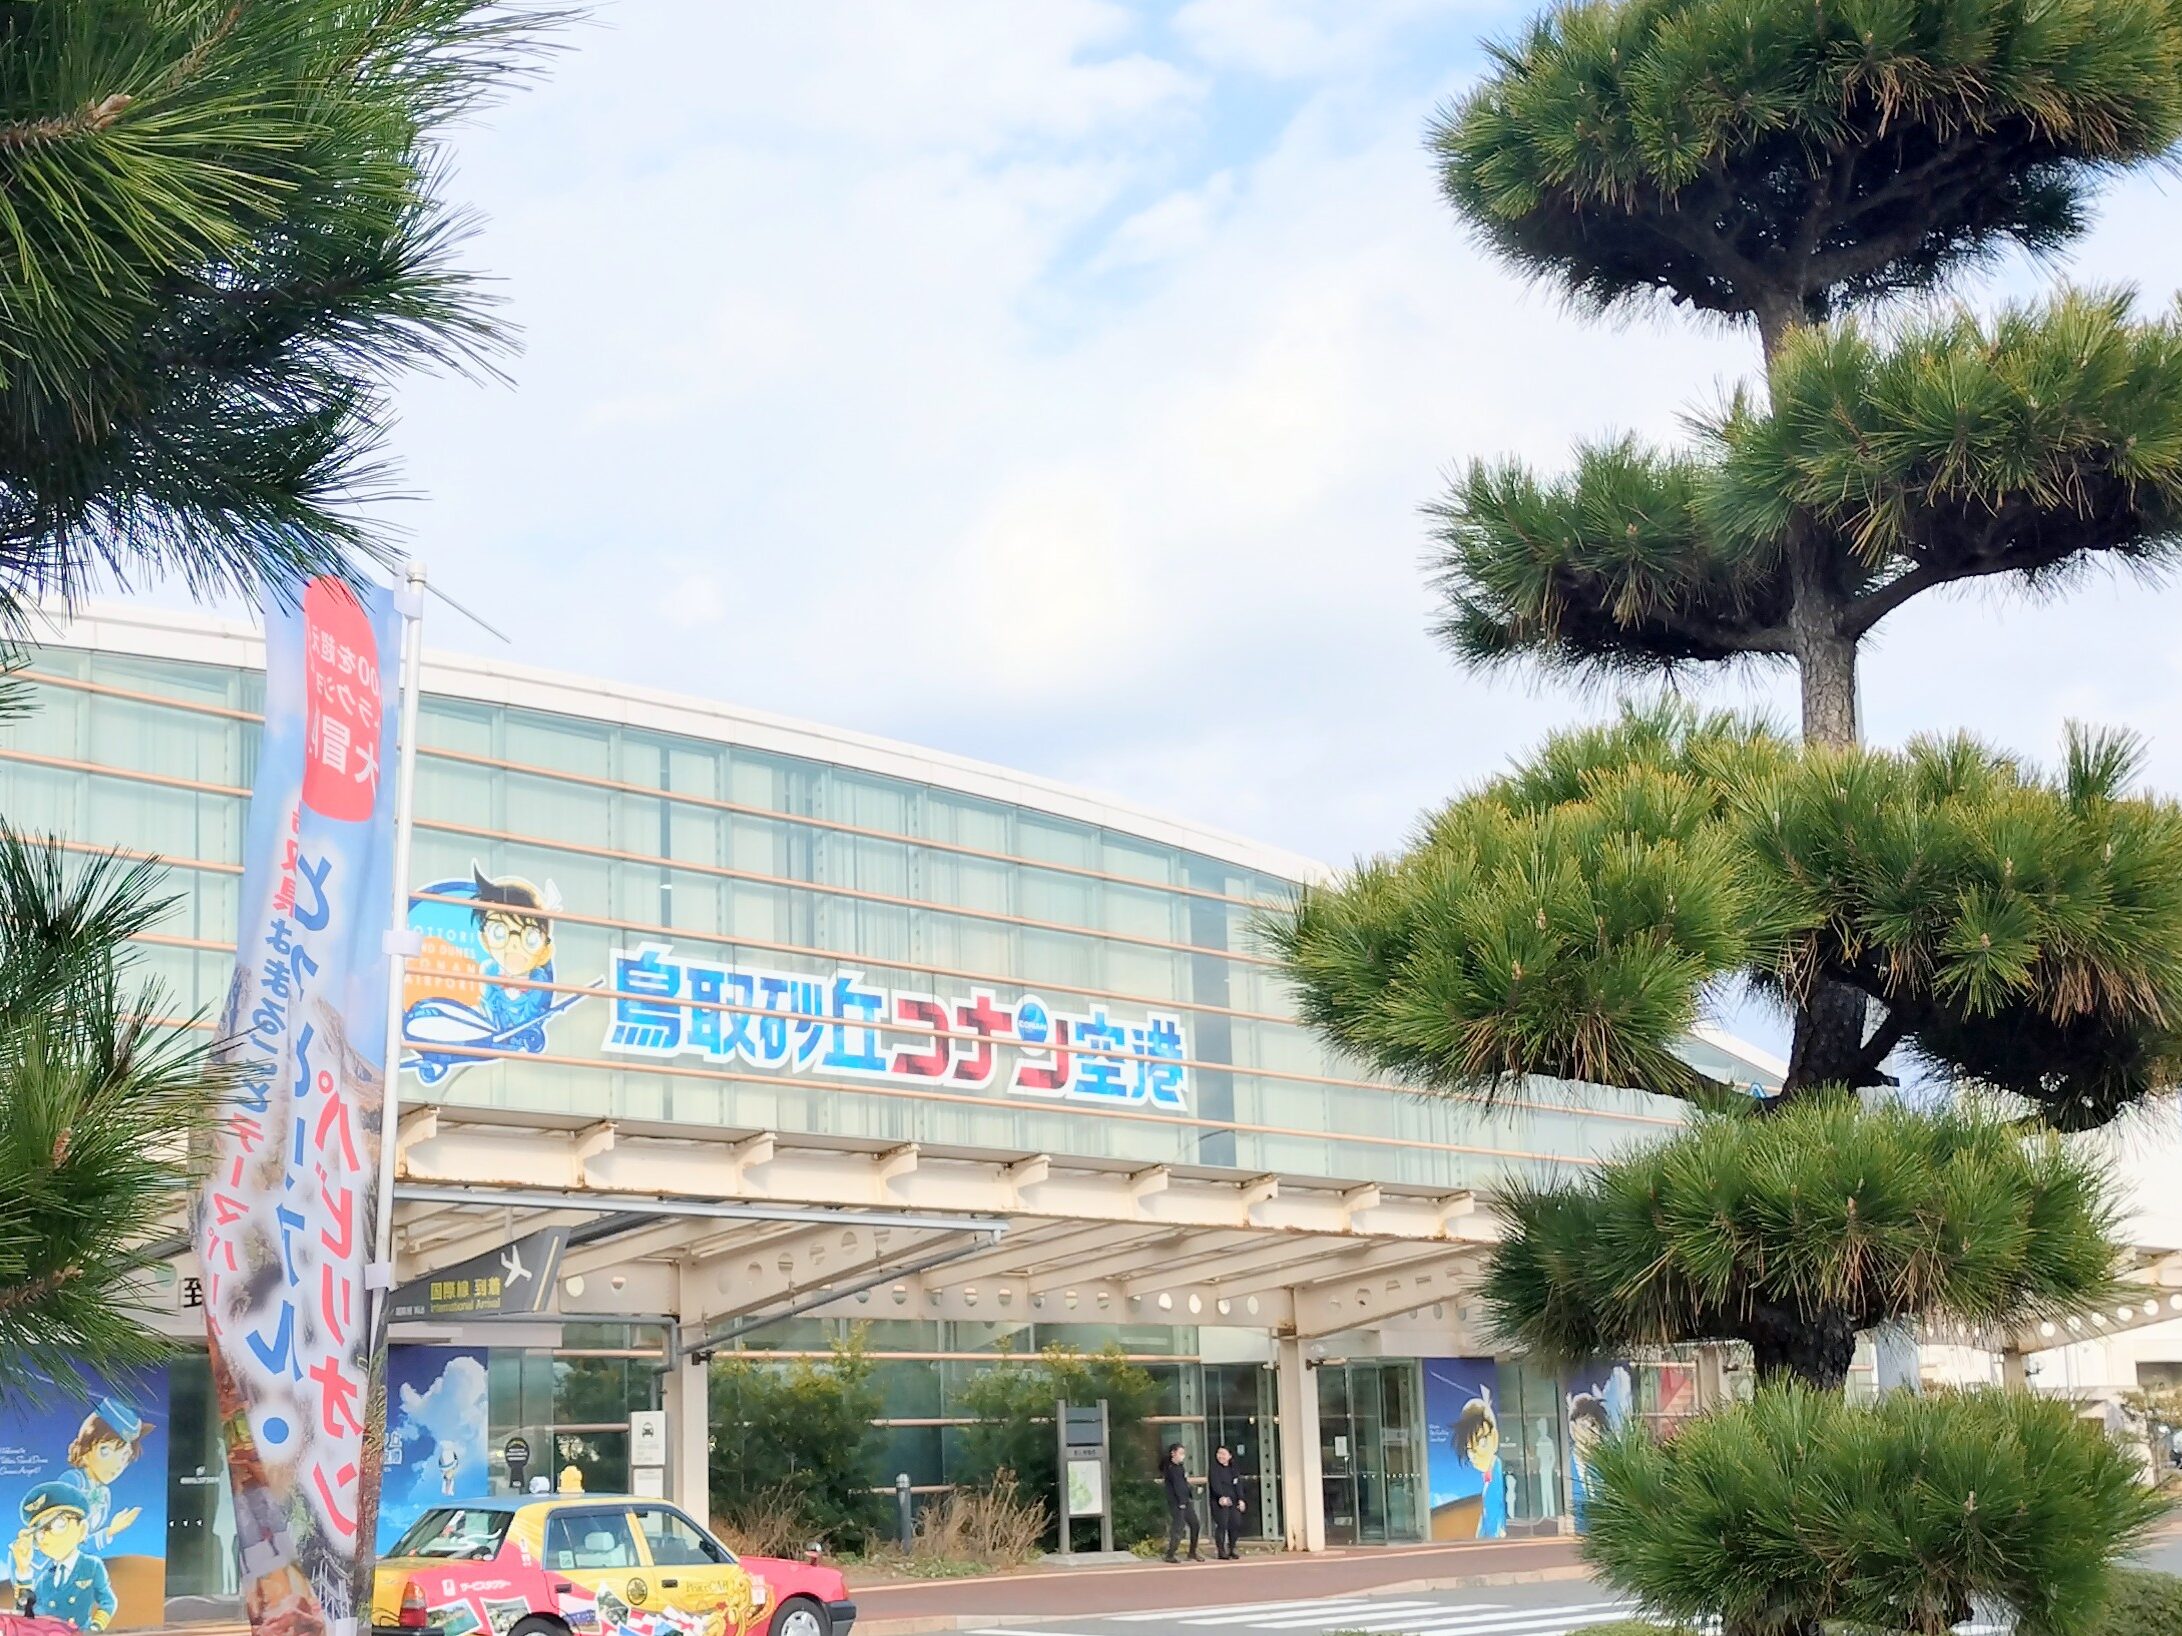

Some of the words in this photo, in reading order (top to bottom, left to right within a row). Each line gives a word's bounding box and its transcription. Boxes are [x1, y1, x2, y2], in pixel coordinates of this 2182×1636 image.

[407, 923, 474, 943] OTTORI
[611, 951, 1184, 1104] 鳥取砂丘コナン空港
